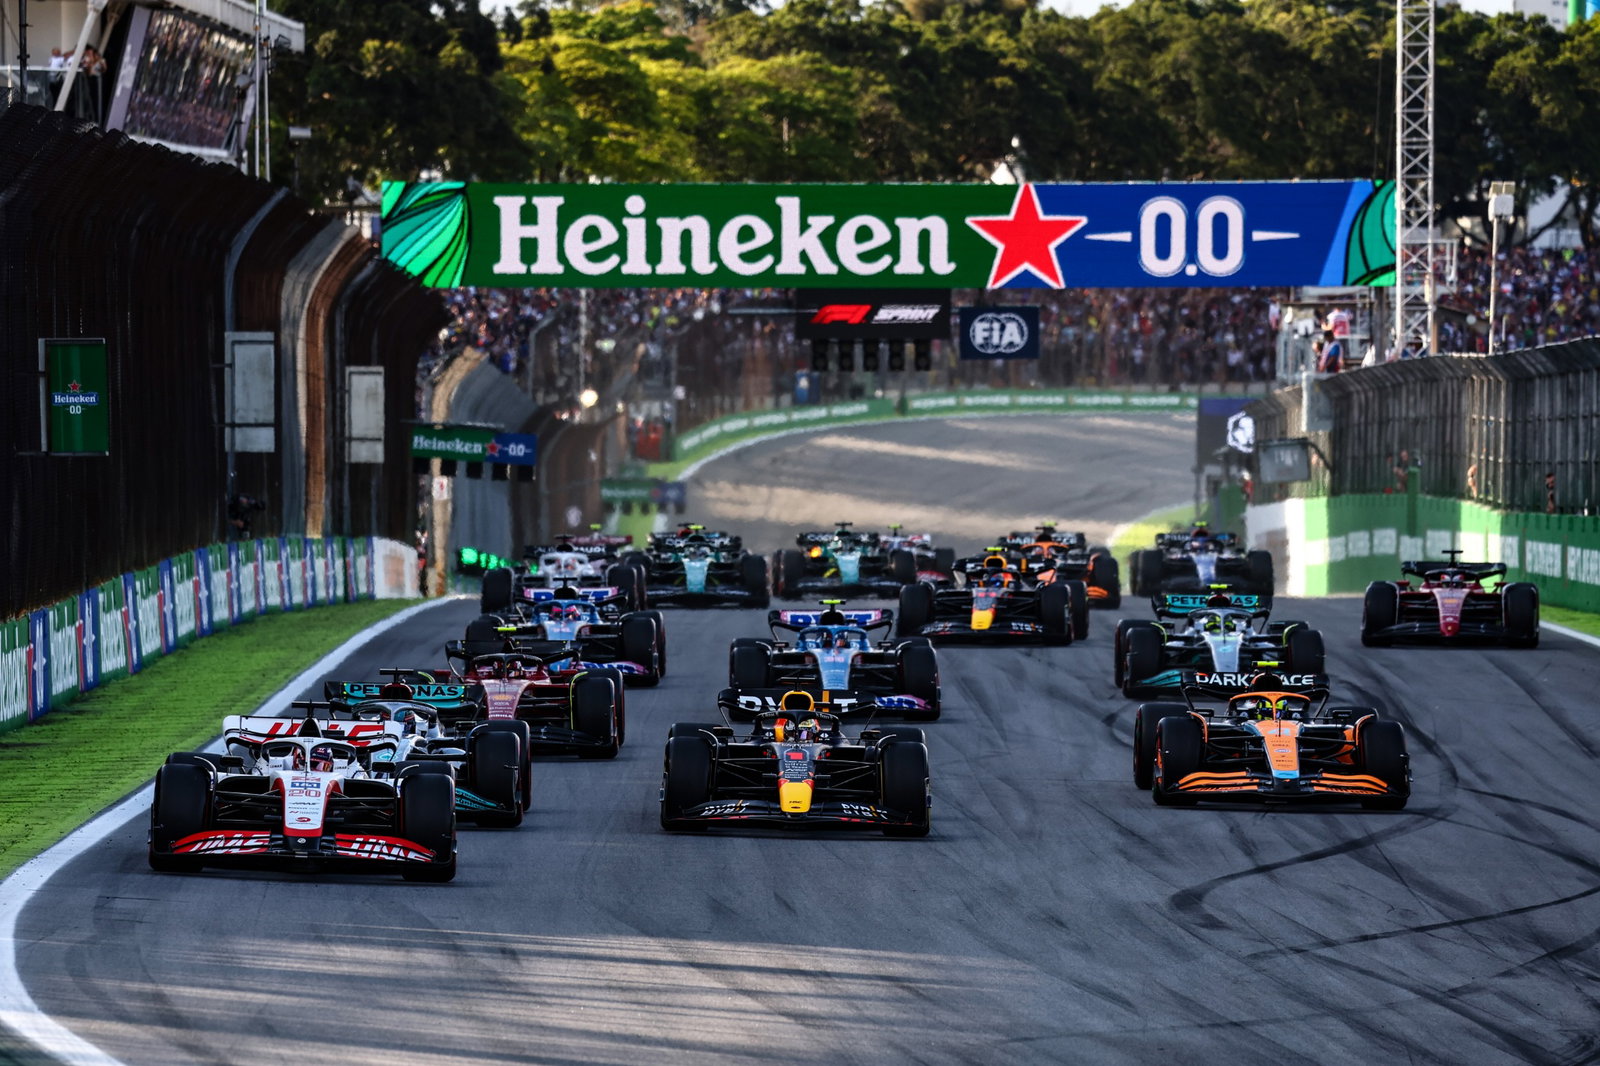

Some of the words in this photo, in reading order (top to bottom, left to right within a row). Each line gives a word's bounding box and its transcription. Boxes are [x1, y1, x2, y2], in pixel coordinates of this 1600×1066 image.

[493, 195, 957, 275] Heineken
[1139, 196, 1246, 276] 0.0
[811, 304, 872, 324] F1
[873, 305, 941, 323] SPRINT
[54, 394, 96, 403] Heineken
[413, 435, 482, 455] Heineken
[1194, 672, 1314, 688] DARKACE
